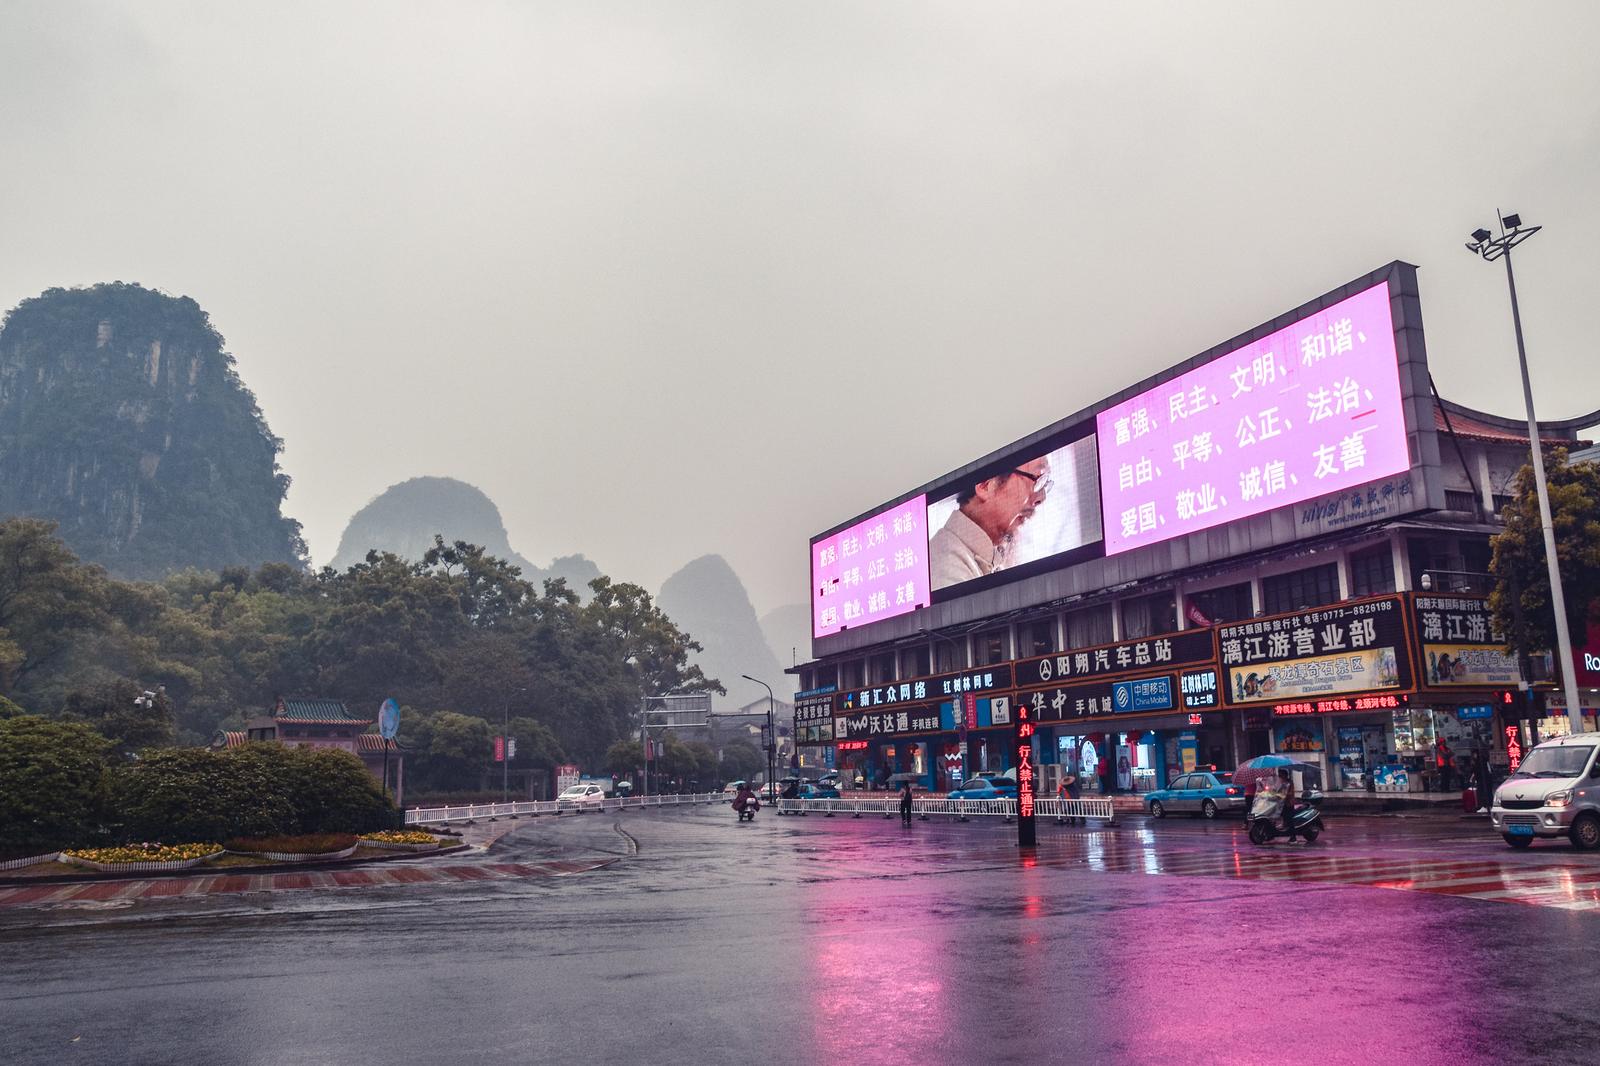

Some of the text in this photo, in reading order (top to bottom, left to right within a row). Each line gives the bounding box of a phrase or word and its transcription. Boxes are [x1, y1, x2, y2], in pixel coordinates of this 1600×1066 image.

[1057, 638, 1172, 677] 阳朔汽车总站
[1222, 618, 1376, 665] 漓江游营业部
[860, 681, 927, 707] 新汇众网络
[1134, 682, 1167, 696] 中国移动
[1076, 696, 1112, 715] 手机城
[870, 712, 909, 734] 沃达通
[1505, 725, 1521, 774] 行人禁止
[1019, 745, 1034, 817] 行人禁止通行
